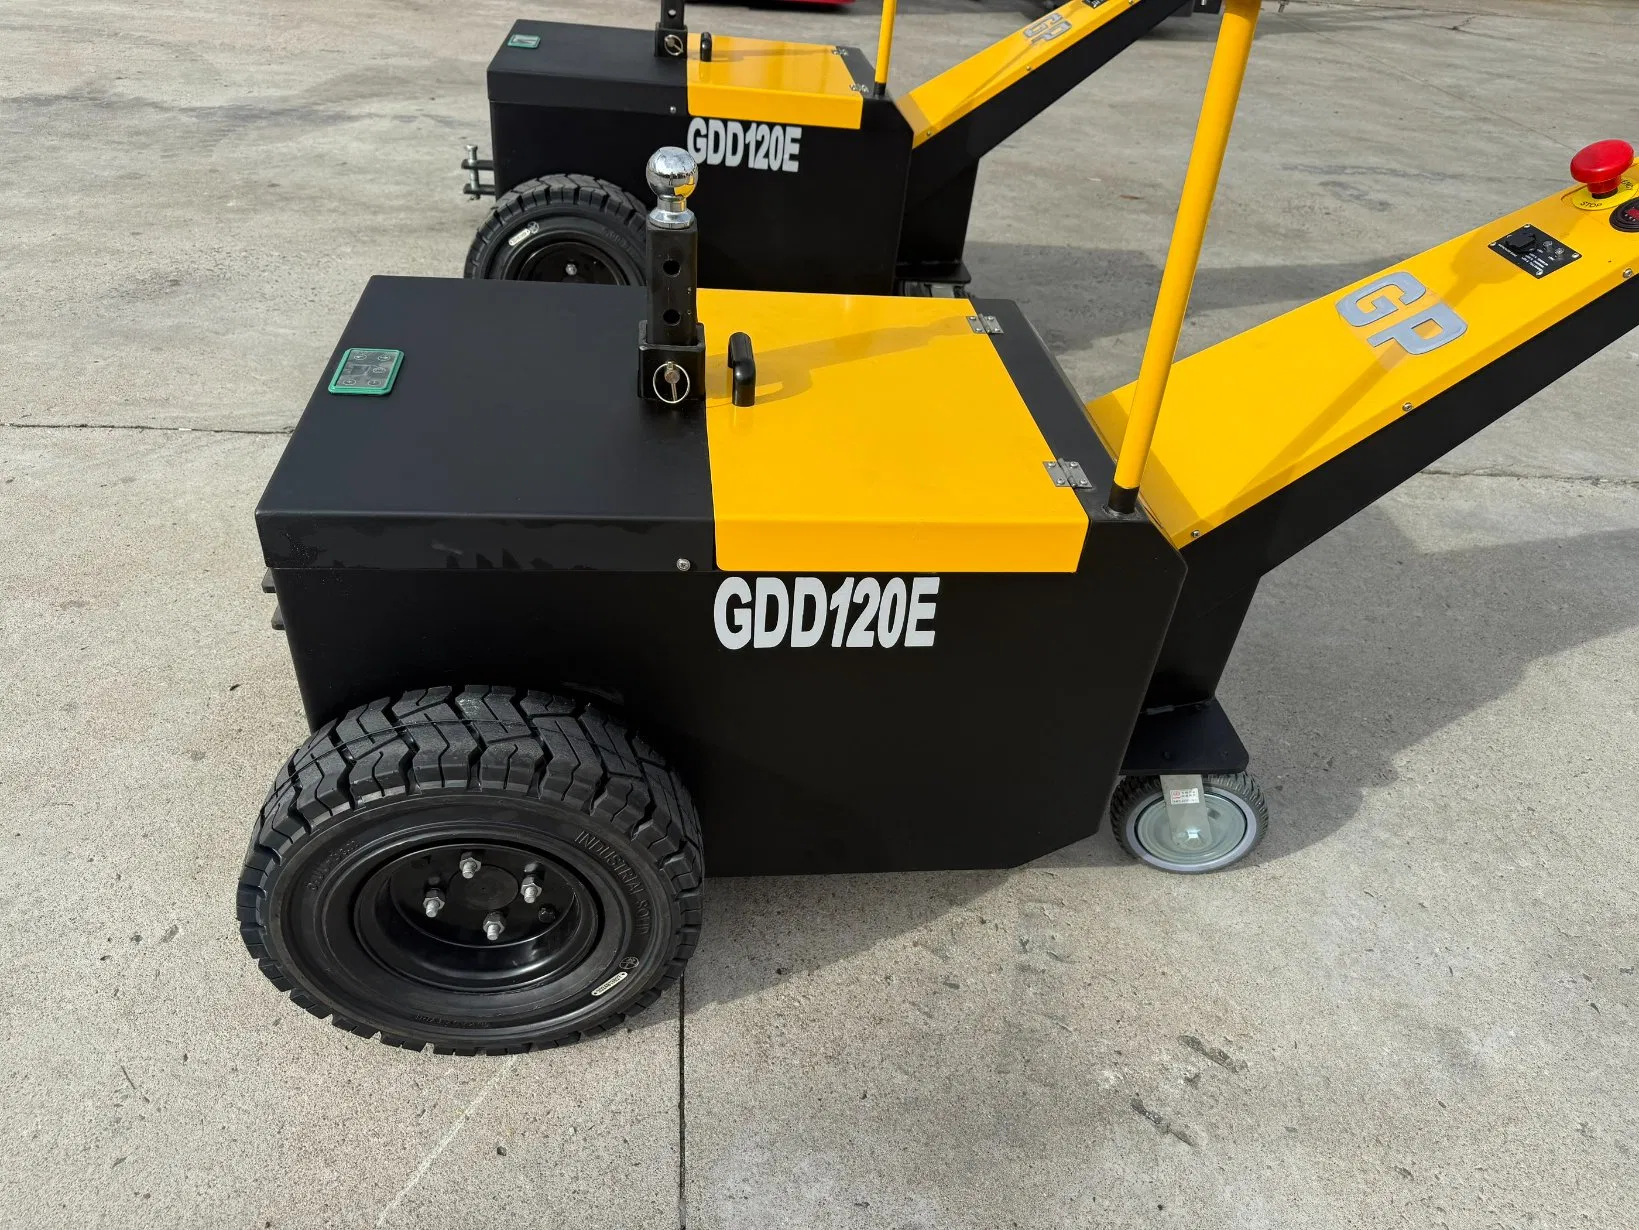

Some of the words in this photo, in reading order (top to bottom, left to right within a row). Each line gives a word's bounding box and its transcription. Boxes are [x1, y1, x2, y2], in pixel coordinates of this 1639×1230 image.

[1023, 12, 1073, 44] GP
[686, 117, 802, 172] GDD120E
[1580, 200, 1603, 208] STOP
[1335, 271, 1469, 355] GP
[713, 576, 941, 650] GDD120E
